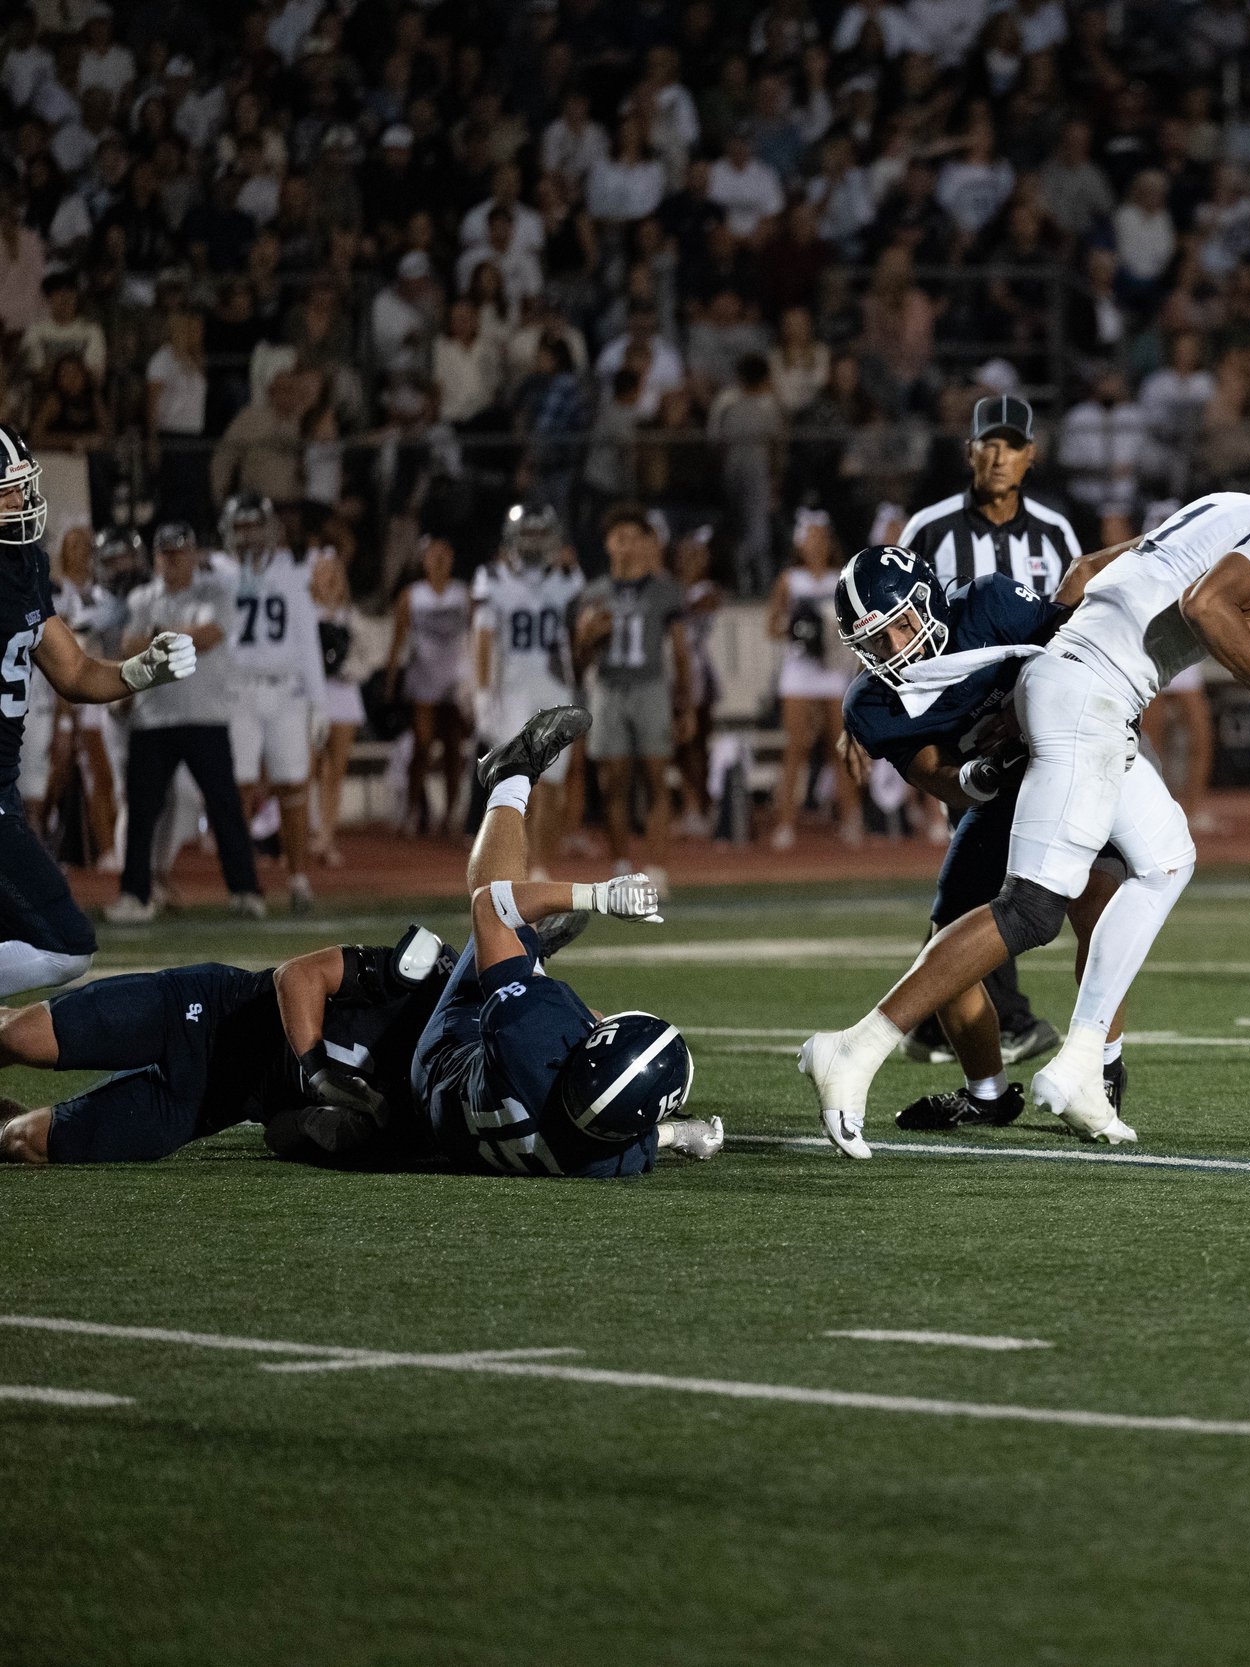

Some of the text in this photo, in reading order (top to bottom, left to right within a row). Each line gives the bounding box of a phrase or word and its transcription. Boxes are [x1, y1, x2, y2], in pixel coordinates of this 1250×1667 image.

[880, 546, 917, 574] 22
[237, 597, 286, 643] 79
[511, 609, 561, 650] 80
[854, 613, 878, 630] Riddell
[655, 1086, 682, 1123] 15
